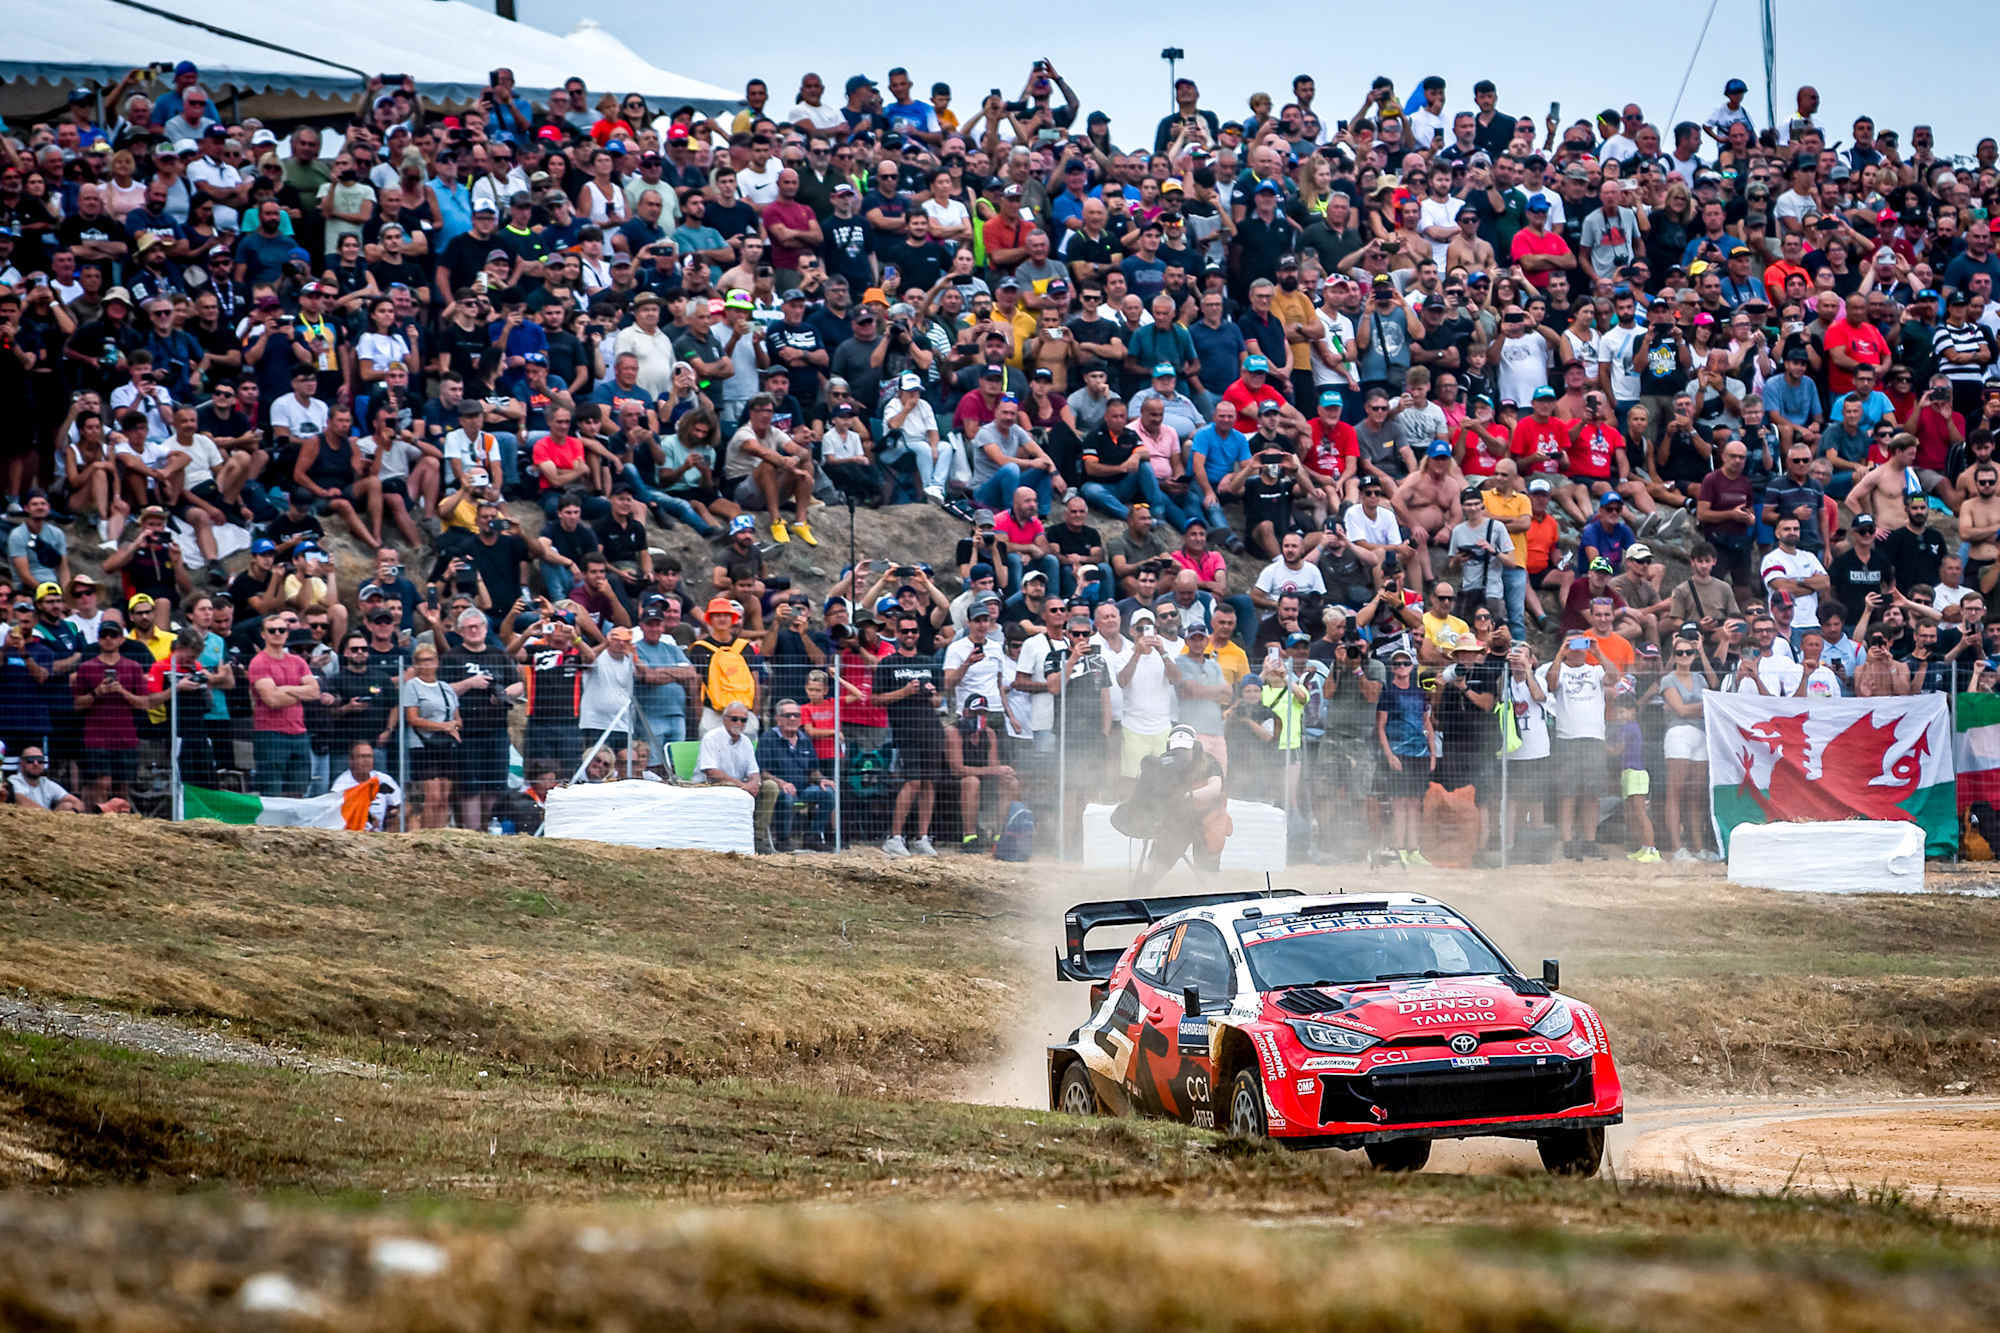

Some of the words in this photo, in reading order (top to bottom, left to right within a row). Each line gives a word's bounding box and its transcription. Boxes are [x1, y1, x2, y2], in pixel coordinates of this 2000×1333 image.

[1286, 911, 1340, 924] TOYOTA
[1398, 997, 1495, 1015] DENSO
[1323, 1015, 1378, 1032] codebeamer
[1411, 1011, 1497, 1026] TAMADIC
[1179, 1022, 1209, 1036] SARDEGN
[1575, 1008, 1600, 1053] Panasonic
[1583, 1007, 1609, 1055] AUTOMOTIVE
[1252, 1032, 1278, 1082] AUTOMOTIVE
[1262, 1030, 1287, 1079] Panasonic
[1296, 1081, 1315, 1092] OMP
